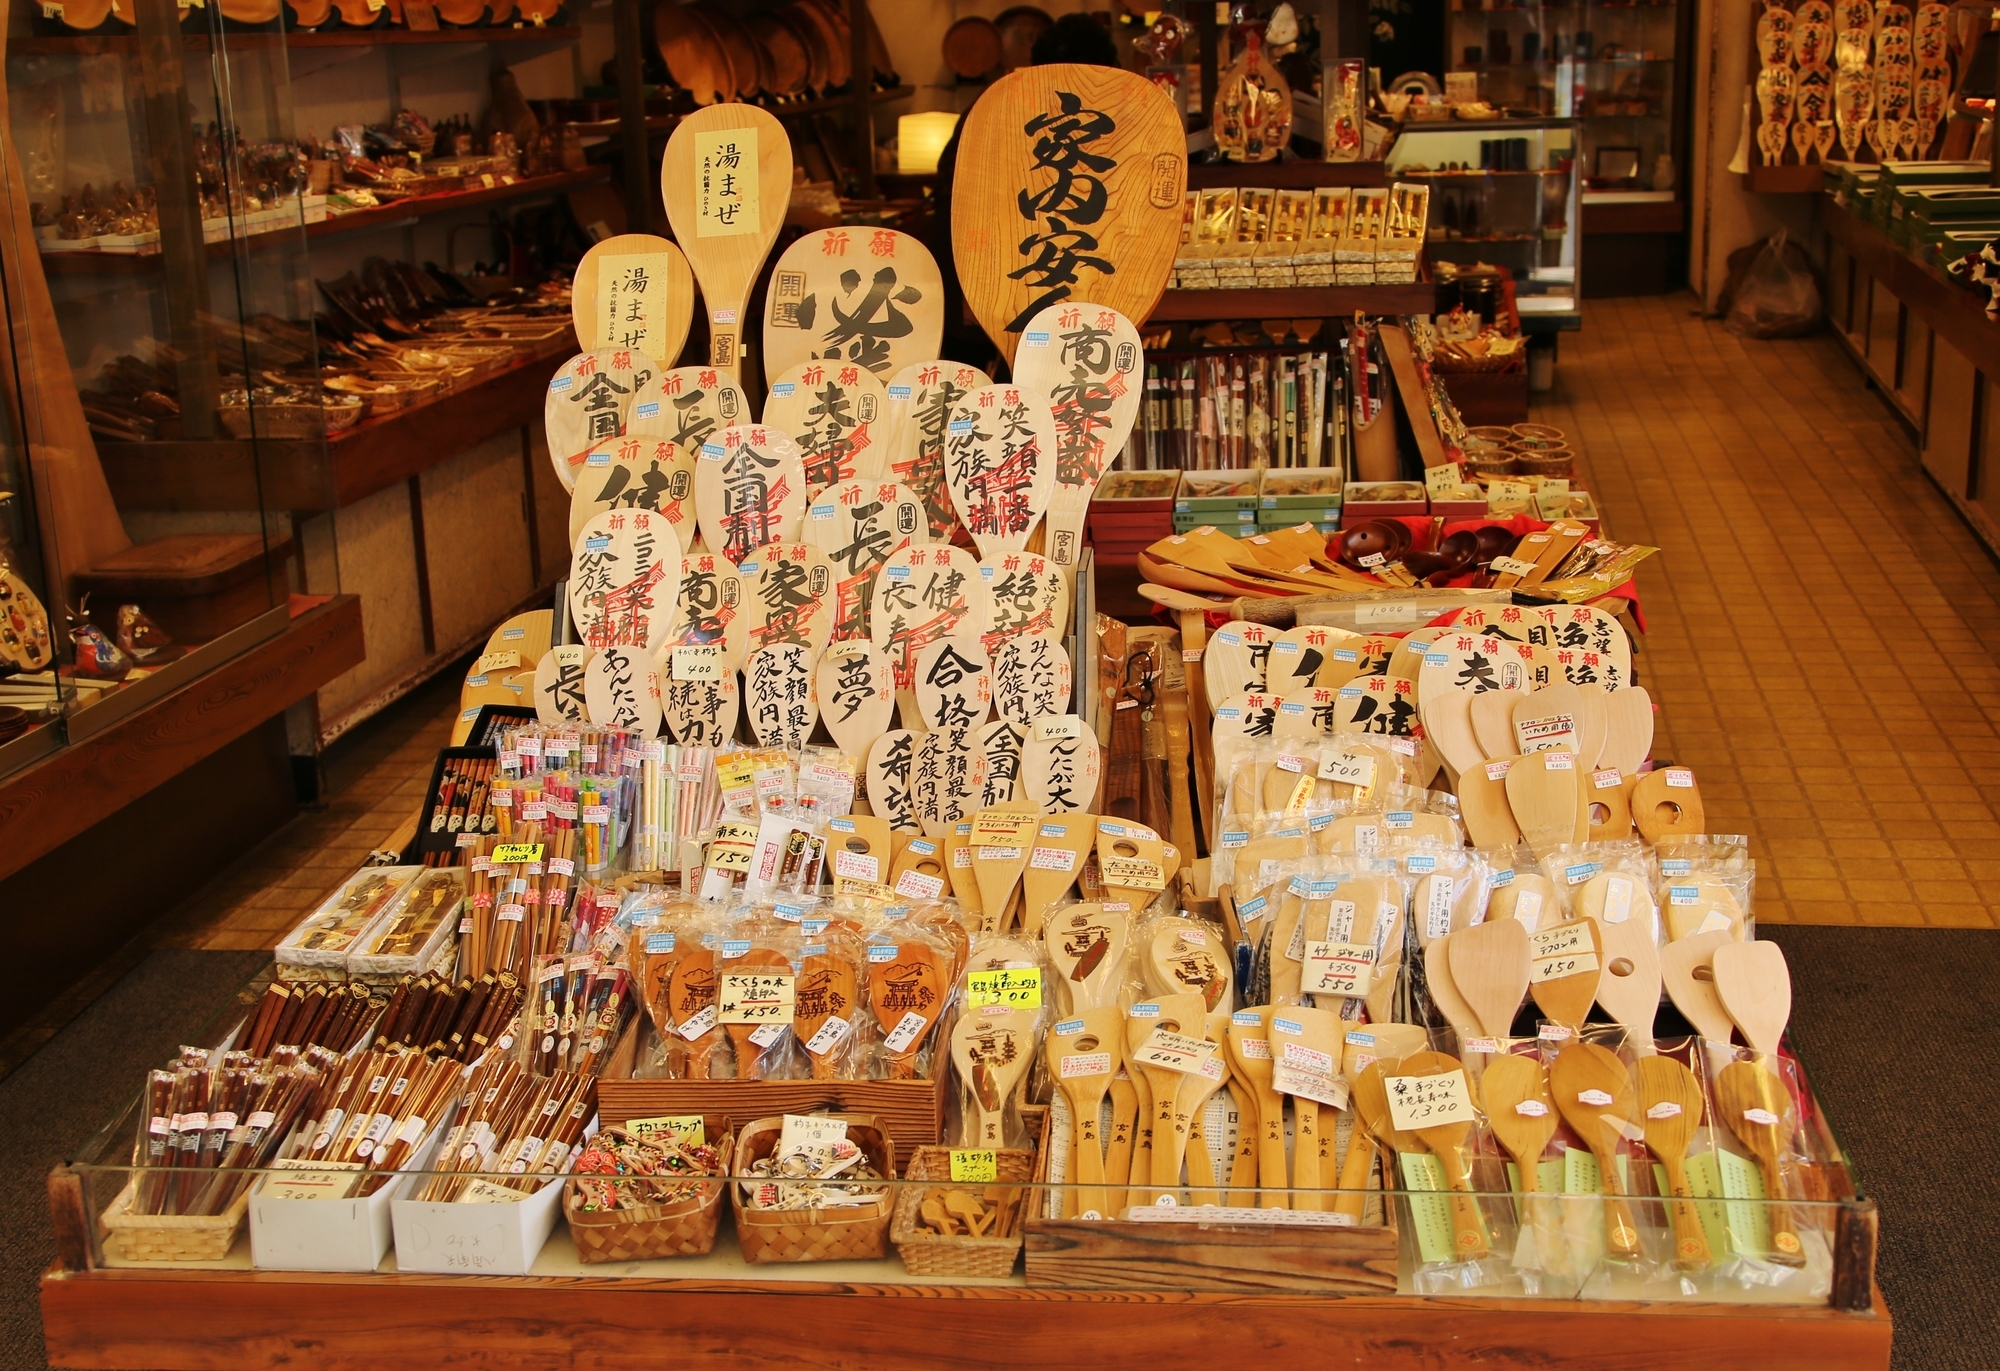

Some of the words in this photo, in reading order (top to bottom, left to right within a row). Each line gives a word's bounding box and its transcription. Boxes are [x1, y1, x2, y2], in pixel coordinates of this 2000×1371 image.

[714, 143, 741, 225] 湯まぜ
[1154, 160, 1180, 200] 開運
[821, 230, 897, 258] 祈願
[619, 267, 650, 350] 湯まぜ
[775, 274, 802, 322] 開運
[1058, 308, 1116, 332] 祈願
[715, 337, 732, 365] 宮島
[576, 351, 633, 377] 祈願
[661, 370, 719, 396] 祈願
[801, 365, 859, 387] 祈願
[918, 366, 975, 388] 祈願
[721, 390, 736, 415] 開運
[861, 397, 874, 420] 開運
[978, 389, 1020, 408] 祈願
[725, 429, 767, 448] 祈願
[618, 439, 675, 462] 祈願
[948, 407, 998, 535] 家族円満
[999, 402, 1037, 532] 笑顔一番
[840, 484, 898, 505] 祈願
[608, 514, 650, 531] 祈願
[900, 505, 914, 530] 開運
[766, 544, 807, 562] 祈願
[908, 549, 951, 566] 祈願
[1054, 532, 1072, 563] 宮島
[1002, 554, 1046, 576] 祈願
[881, 580, 918, 671] 長寿
[1463, 607, 1523, 627] 祈願
[1243, 626, 1266, 643] 祈
[1305, 629, 1329, 646] 祈
[559, 652, 579, 662] 400
[1362, 640, 1386, 656] 祈
[1456, 636, 1499, 656] 祈願
[687, 665, 712, 675] 400
[1558, 651, 1600, 667] 祈願
[832, 654, 876, 724] 夢
[926, 643, 984, 728] 合格
[1313, 688, 1331, 703] 祈
[1369, 677, 1412, 694] 祈願
[752, 651, 784, 748] 家族円満
[1045, 726, 1068, 736] 400
[915, 733, 945, 822] 家族円満
[943, 729, 973, 824] 笑顔最高
[1325, 761, 1360, 777] 500
[716, 852, 750, 862] 150
[1543, 960, 1575, 976] 450
[728, 976, 788, 988] さくらの木
[1318, 977, 1354, 990] 550
[831, 1020, 847, 1041] 宮島
[907, 1016, 925, 1040] 宮島
[1415, 1079, 1456, 1092] 手づくり
[1159, 1101, 1172, 1120] 宮島
